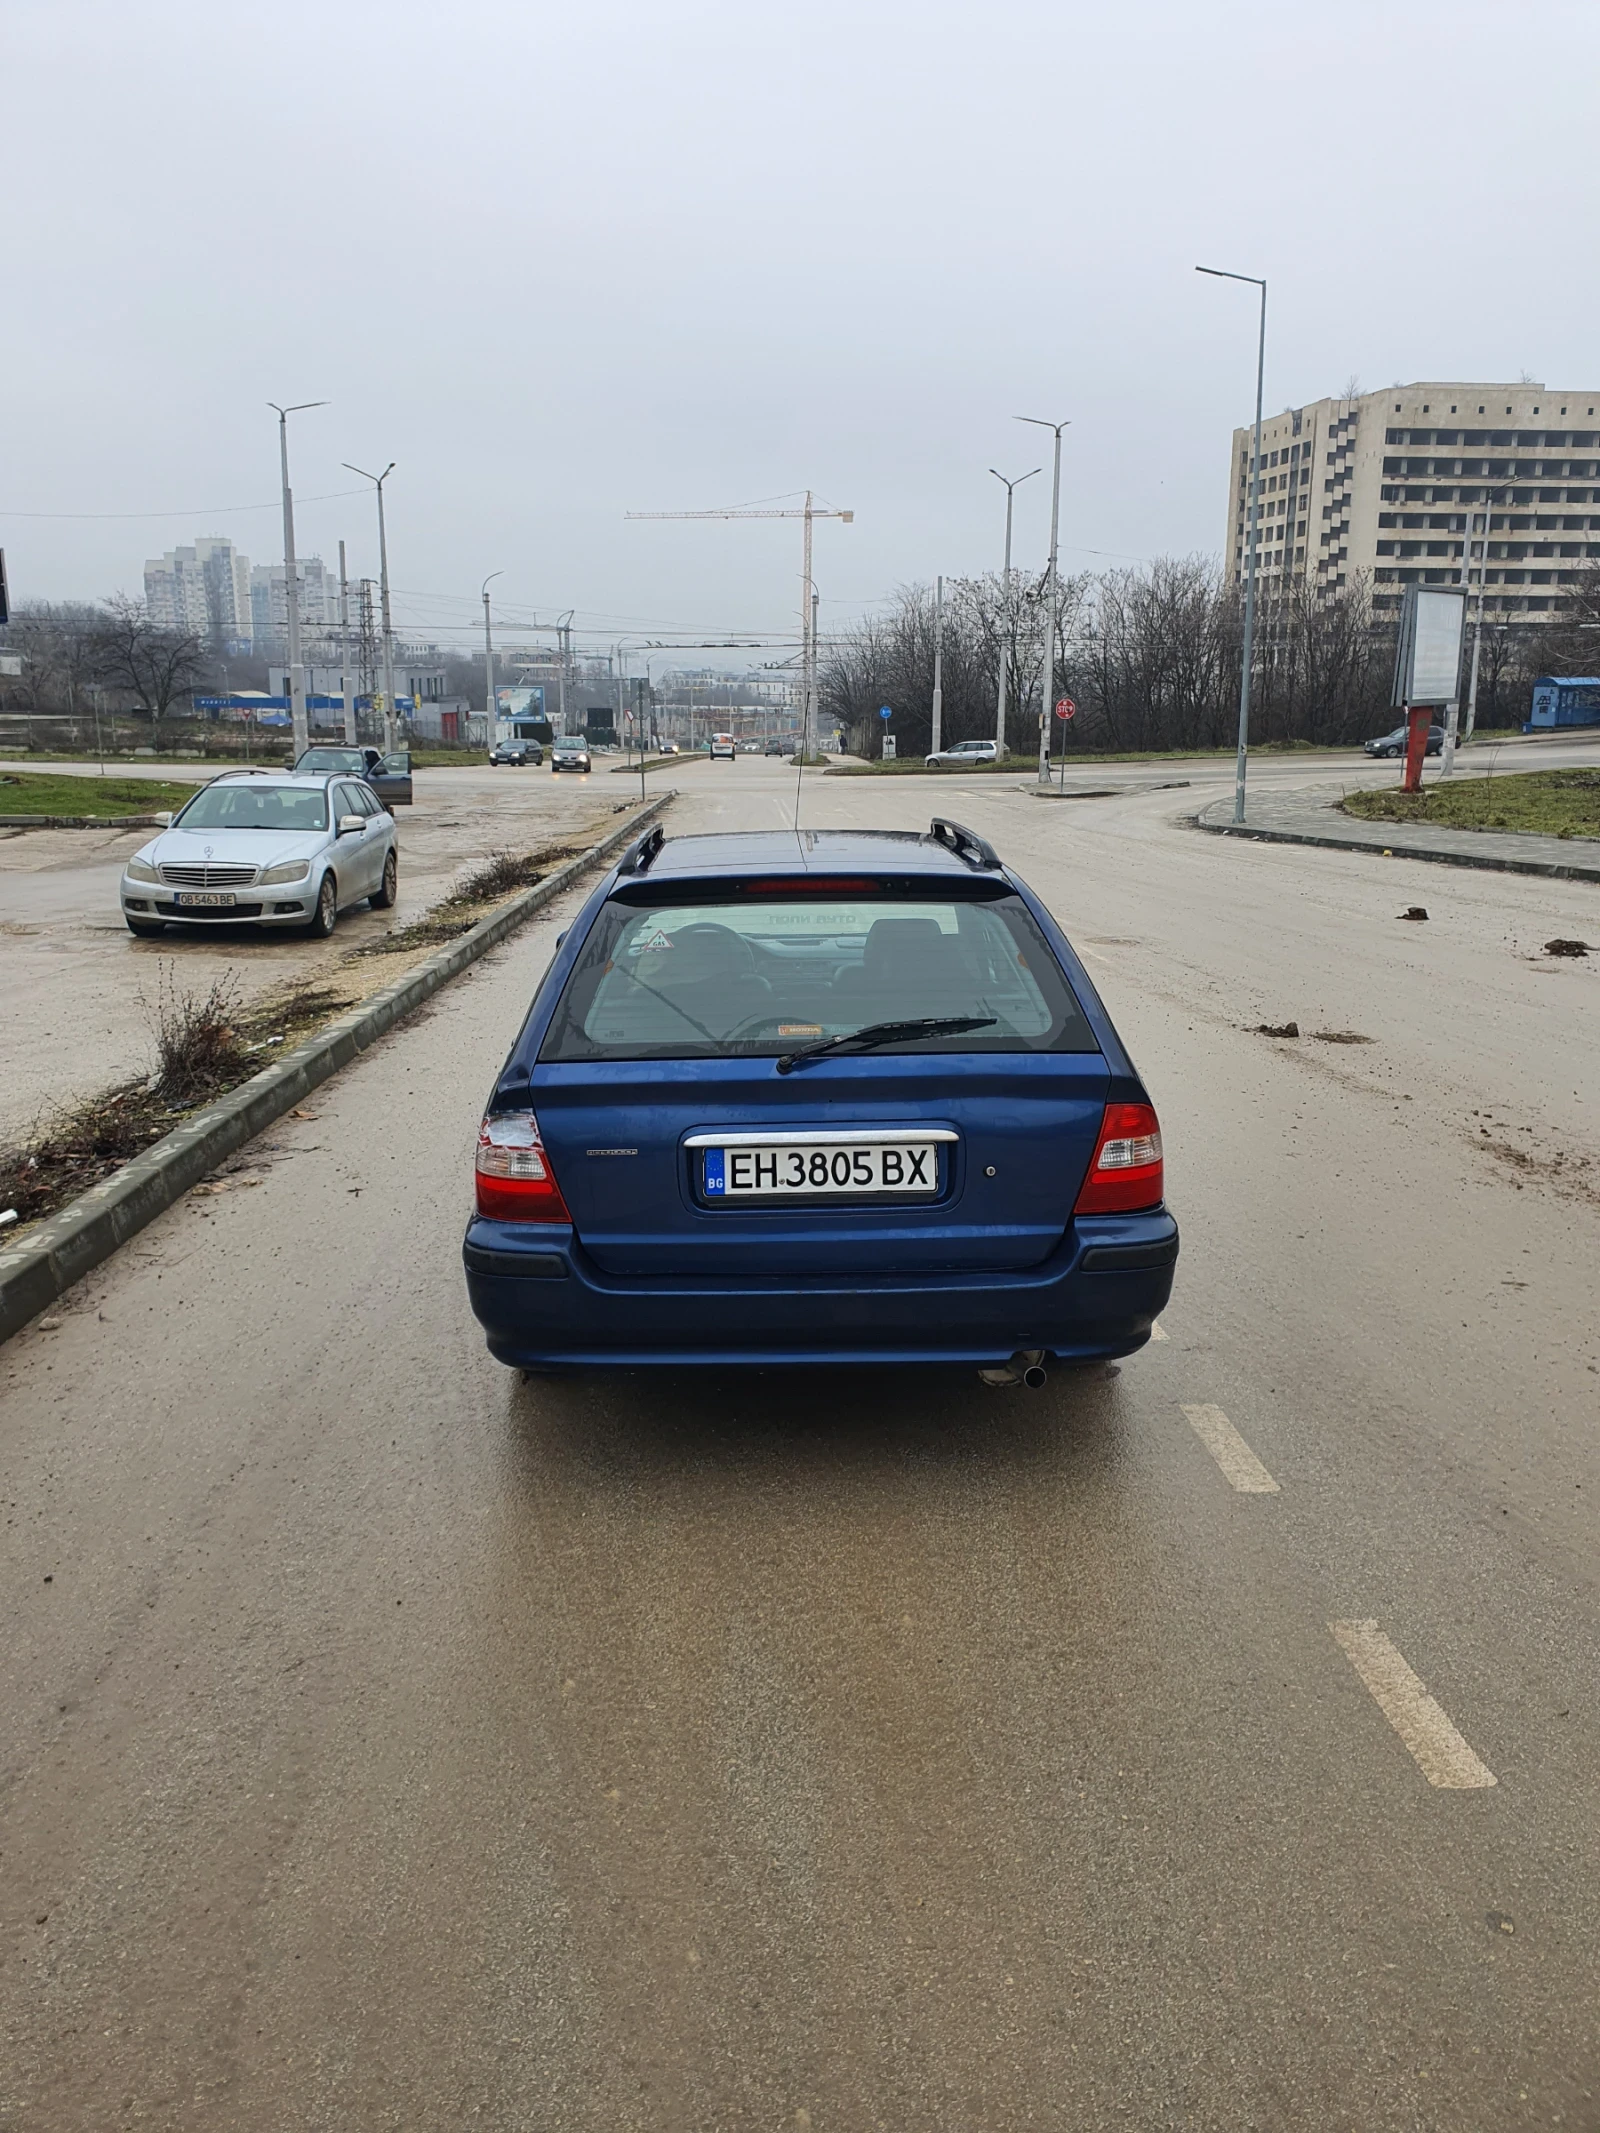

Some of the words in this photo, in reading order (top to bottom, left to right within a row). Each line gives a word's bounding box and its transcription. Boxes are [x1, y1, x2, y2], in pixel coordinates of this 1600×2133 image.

[181, 895, 194, 904] OB
[194, 895, 218, 904] 5463
[220, 895, 233, 904] BE
[730, 1153, 778, 1188] EH
[786, 1151, 874, 1187] 3805
[882, 1150, 928, 1186] BX
[708, 1178, 724, 1188] BG
